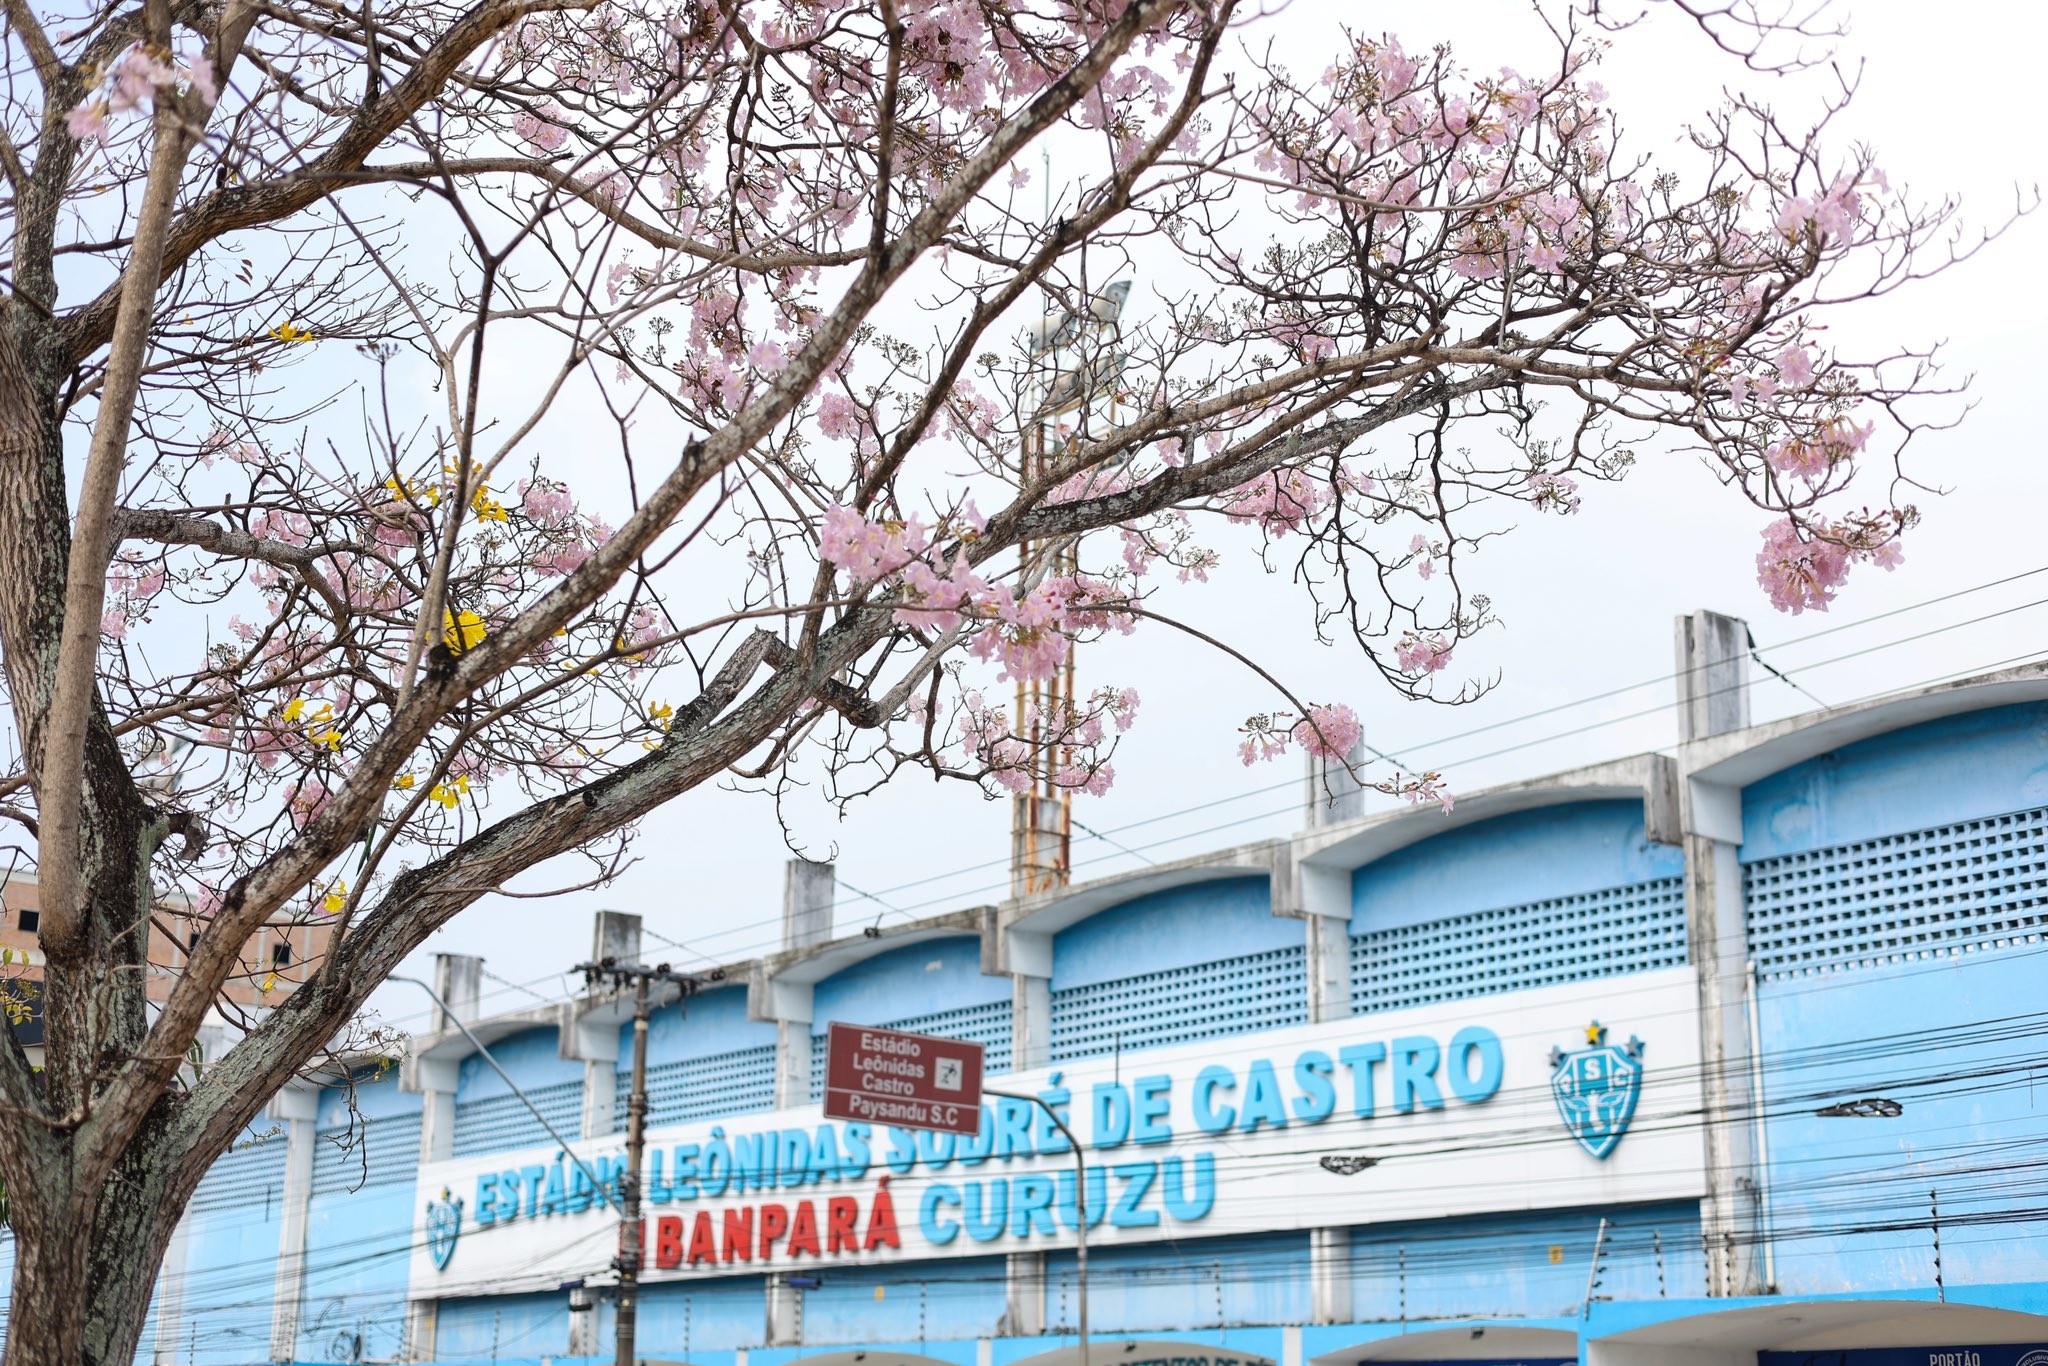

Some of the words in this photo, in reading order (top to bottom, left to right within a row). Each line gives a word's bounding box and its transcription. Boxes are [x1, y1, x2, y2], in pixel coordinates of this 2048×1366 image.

[861, 1032, 921, 1057] Estádio
[852, 1052, 925, 1078] Leônidas
[862, 1073, 915, 1096] Castro
[650, 1121, 872, 1204] LEÔNIDAS
[1092, 1074, 1173, 1150] DE
[1192, 1026, 1504, 1134] CASTRO
[849, 1094, 927, 1121] Paysandu
[930, 1104, 958, 1126] S.C
[656, 1175, 901, 1270] BANPARÁ
[919, 1152, 1215, 1245] CURUZU
[1929, 1350, 1980, 1366] PORTÃO
